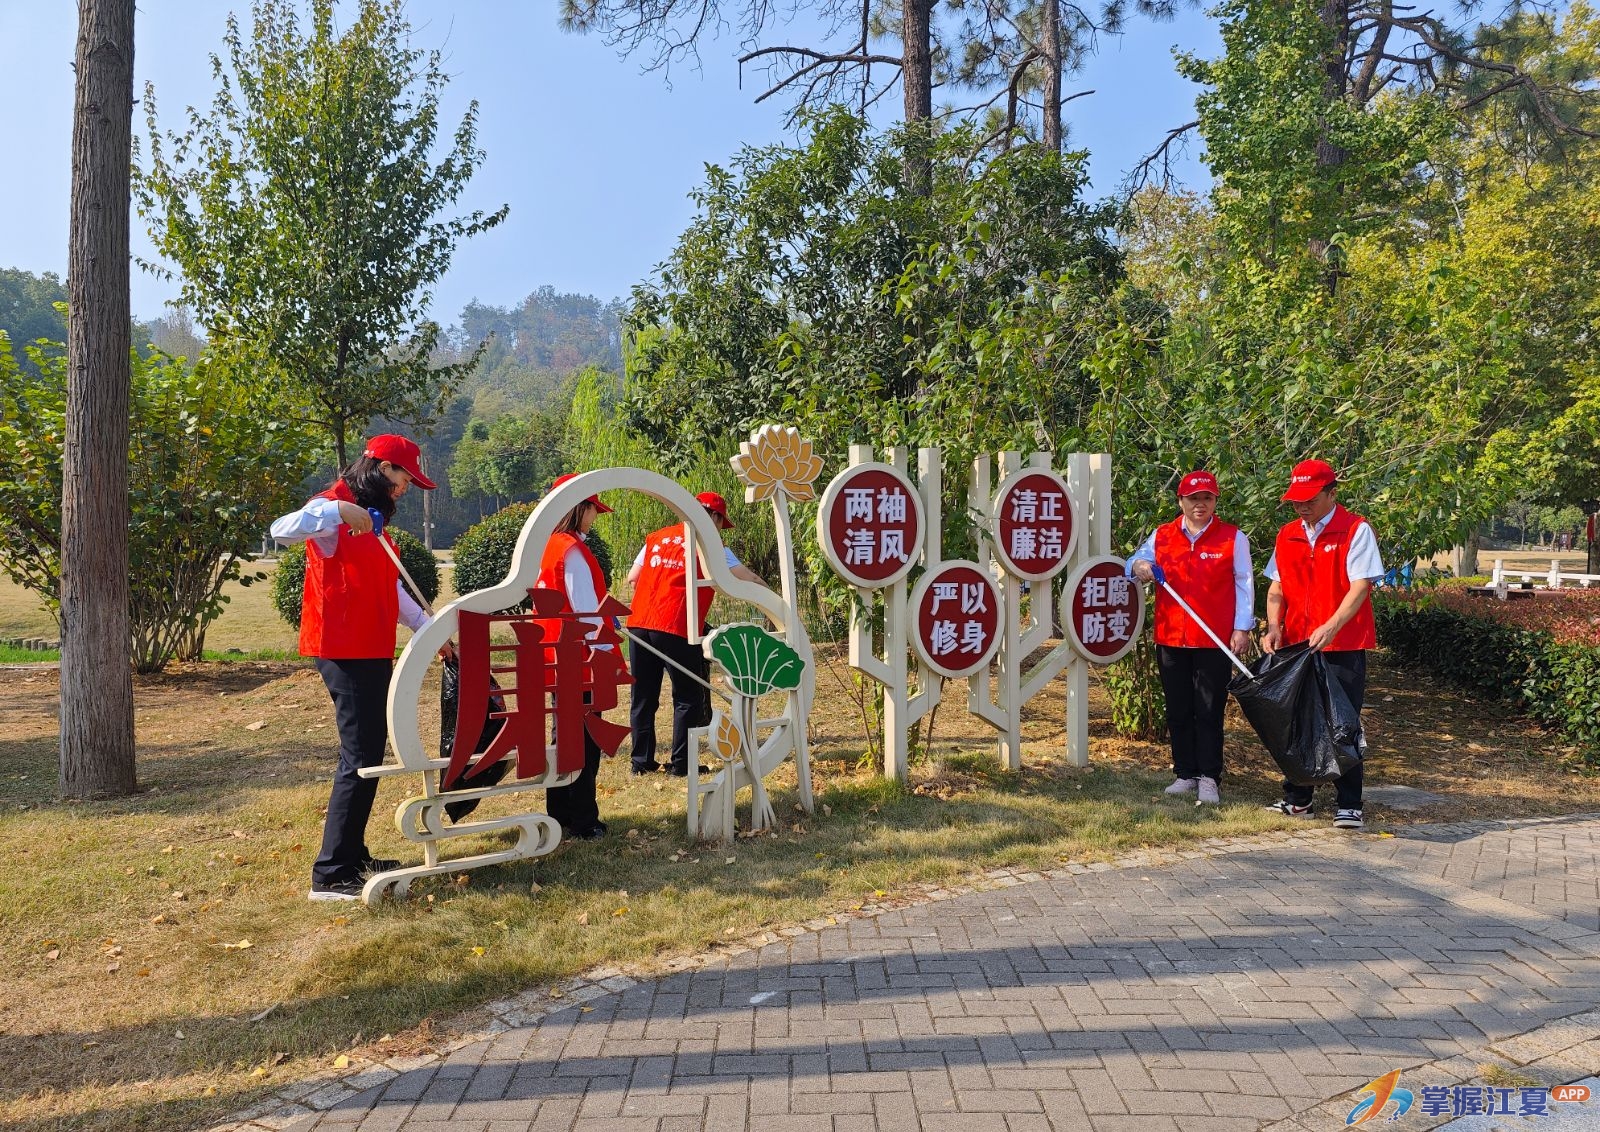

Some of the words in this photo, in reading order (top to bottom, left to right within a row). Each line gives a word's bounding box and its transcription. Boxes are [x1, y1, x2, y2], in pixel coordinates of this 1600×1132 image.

[843, 487, 907, 524] 两袖
[1011, 488, 1064, 523] 清正
[843, 528, 909, 565] 清风
[1010, 527, 1063, 560] 廉洁
[931, 582, 987, 616] 严以
[1081, 576, 1131, 608] 拒腐
[930, 620, 987, 655] 修身
[1082, 610, 1131, 644] 防变
[442, 588, 636, 789] 廉
